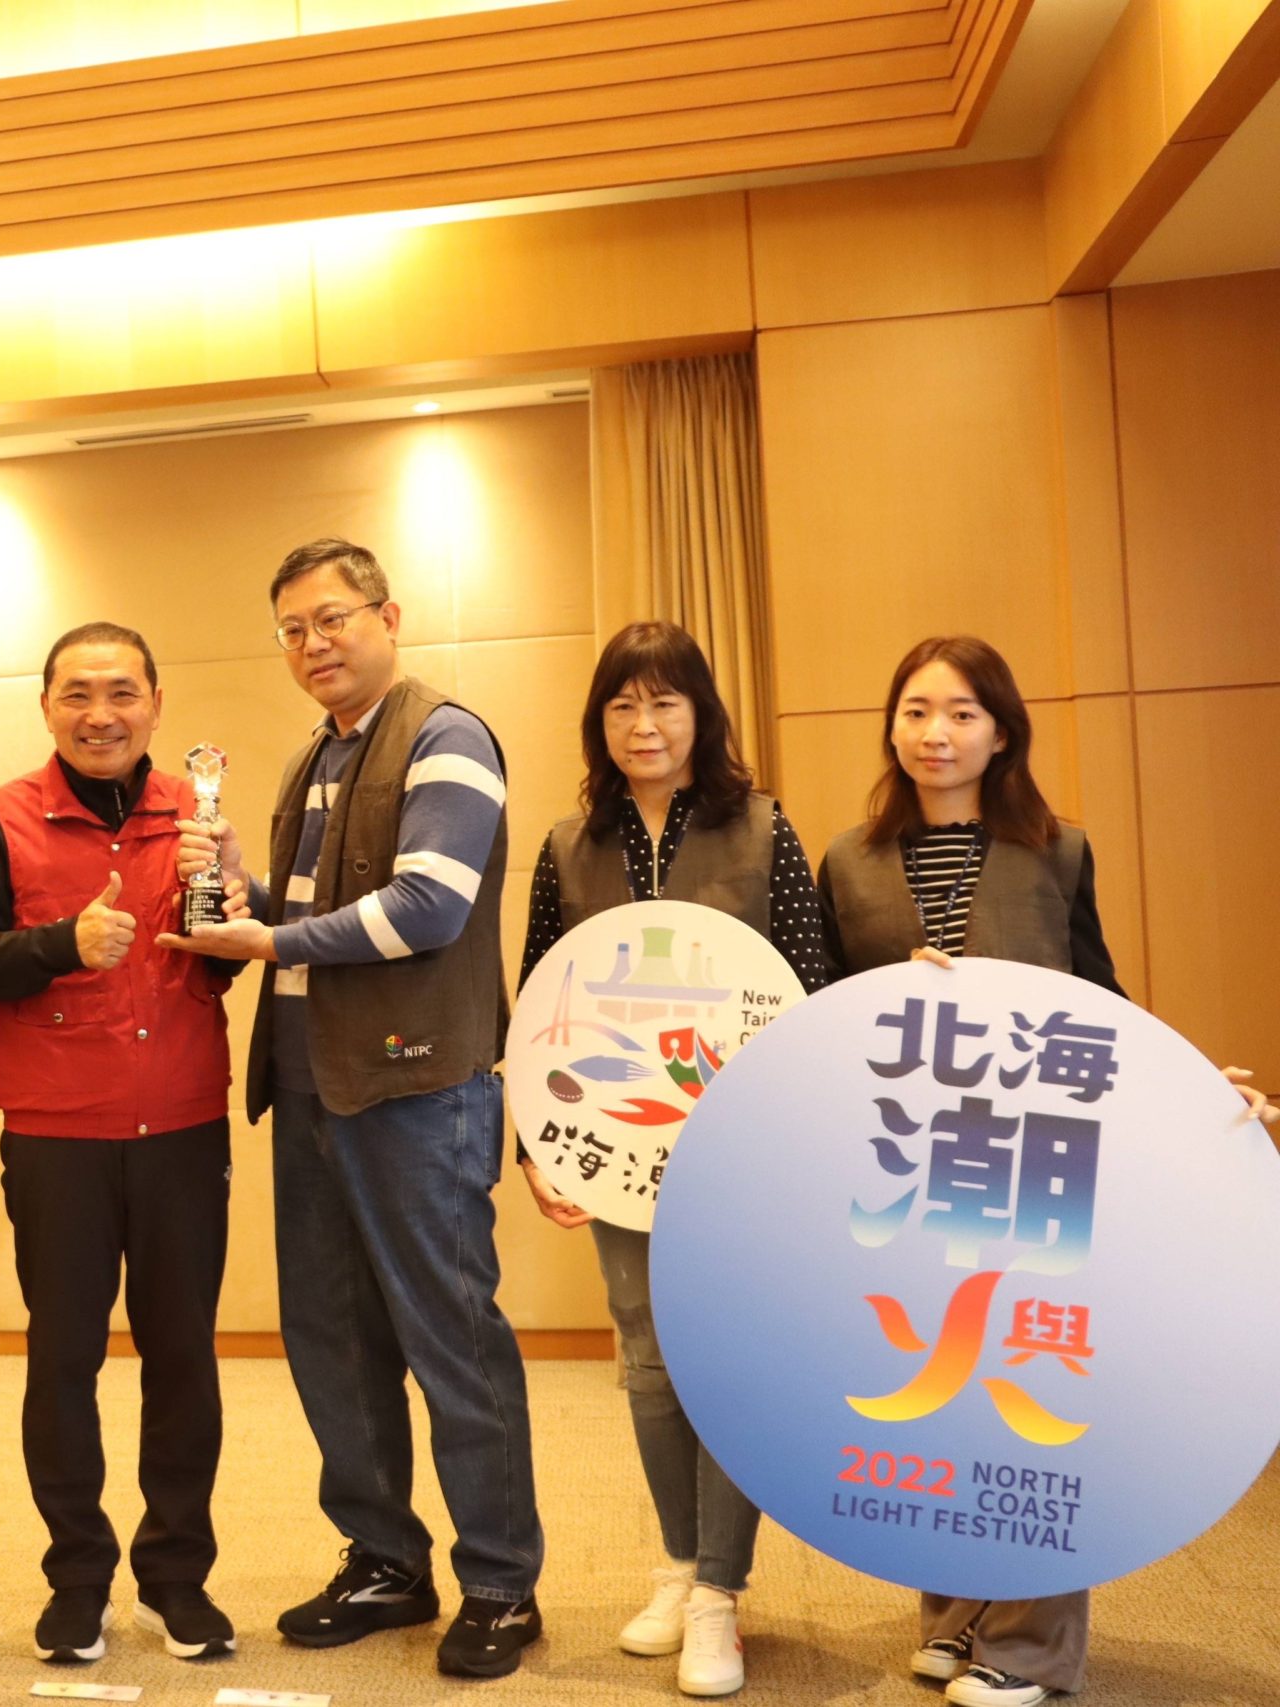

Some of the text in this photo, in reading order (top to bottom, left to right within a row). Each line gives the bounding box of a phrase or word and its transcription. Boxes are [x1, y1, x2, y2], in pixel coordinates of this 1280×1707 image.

[742, 989, 782, 1006] New
[404, 1044, 433, 1058] NTPC
[866, 997, 1119, 1104] 北海
[849, 1095, 1102, 1277] 潮
[1002, 1297, 1095, 1376] 與
[837, 1445, 1082, 1500] 2022 NORTH
[832, 1492, 1077, 1553] LIGHT FESTIVAL
[977, 1489, 1081, 1525] COAST
